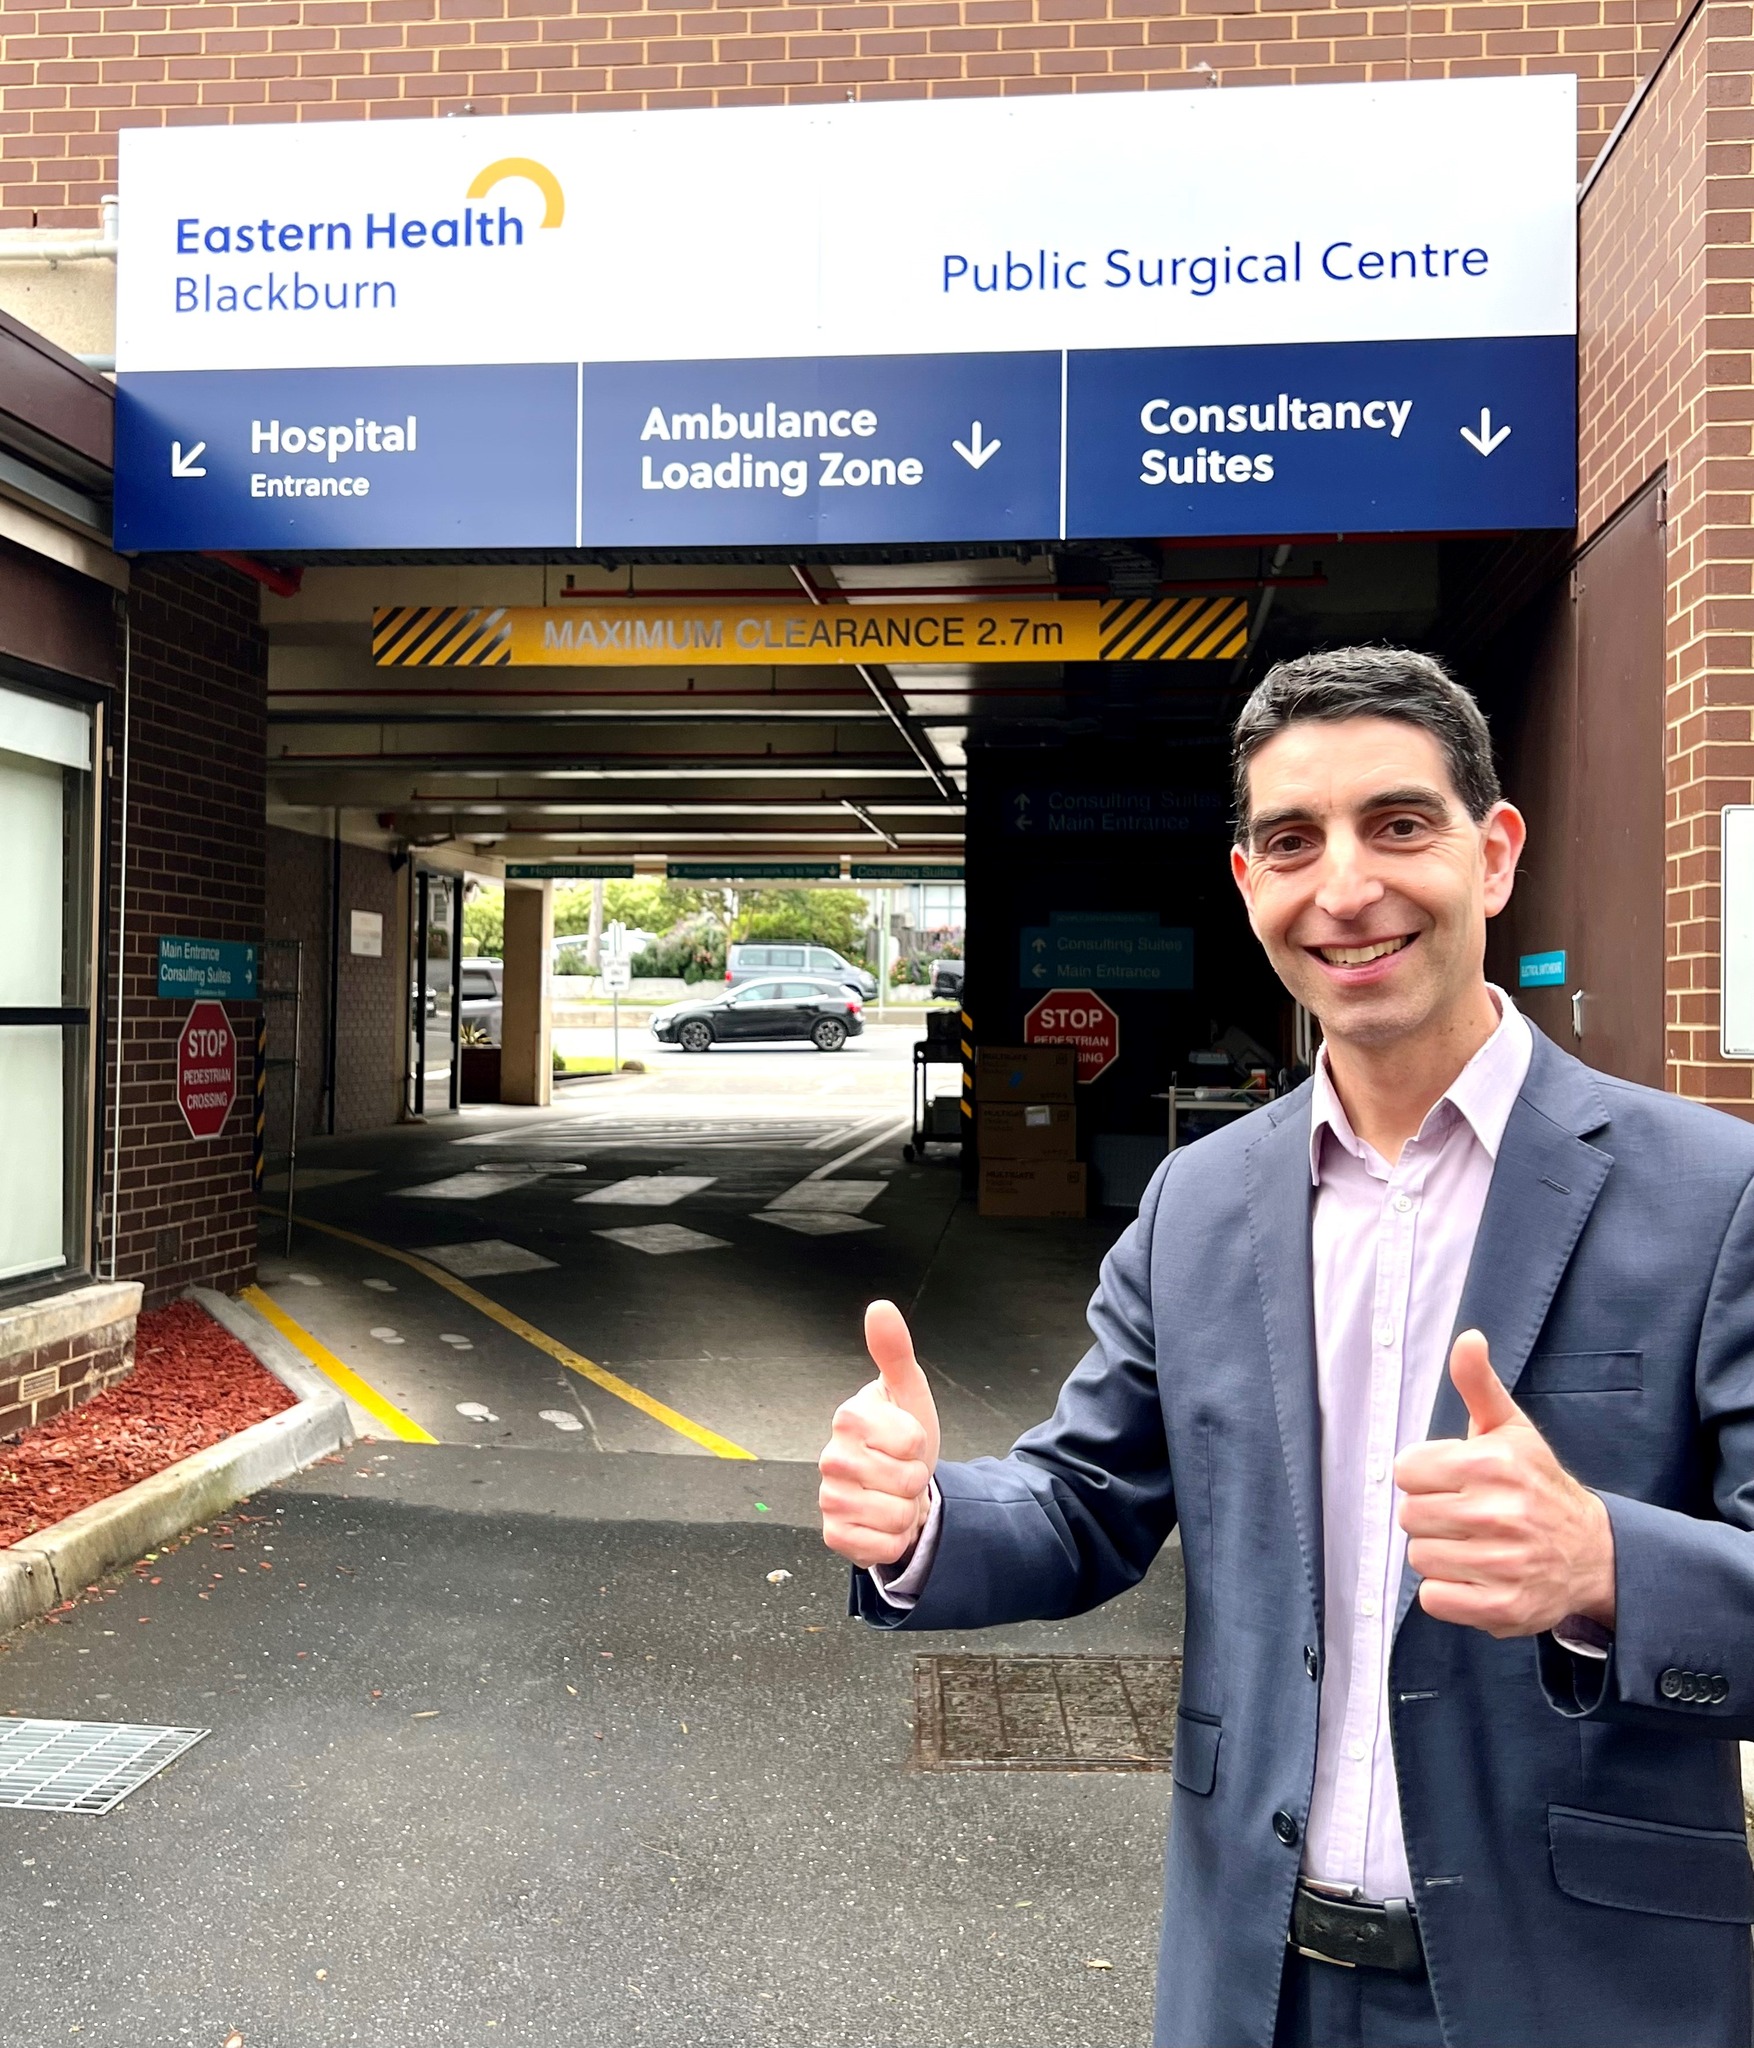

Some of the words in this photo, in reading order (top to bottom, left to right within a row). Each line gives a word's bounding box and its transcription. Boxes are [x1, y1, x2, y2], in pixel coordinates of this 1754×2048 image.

[176, 217, 351, 254] Eastern
[367, 207, 523, 249] Health
[942, 250, 1087, 293] Public
[1106, 242, 1301, 295] Surgical
[1322, 239, 1489, 281] Centre
[175, 272, 396, 312] Blackburn
[640, 403, 877, 441] Ambulance
[1140, 392, 1412, 438] Consultancy
[252, 416, 417, 462] Hospital
[642, 453, 808, 495] Loading
[819, 452, 924, 487] Zone
[1140, 448, 1274, 486] Suites
[251, 474, 369, 498] Entrance
[543, 618, 723, 651] MAXIMUM
[736, 617, 964, 649] CLEARANCE
[977, 617, 1063, 646] 2.7m
[1048, 791, 1151, 812] Consulting
[1160, 790, 1222, 808] Suites
[1048, 813, 1094, 831] Main
[1102, 813, 1190, 831] Entrance
[161, 940, 182, 957] Main
[185, 942, 219, 961] Entrance
[1057, 937, 1133, 953] Consulting
[1138, 937, 1183, 951] Suites
[161, 964, 205, 987] Consulting
[207, 966, 231, 984] Suites
[1057, 964, 1091, 978] Main
[1096, 964, 1160, 978] Entrance
[1040, 1008, 1103, 1029] STOP
[188, 1029, 228, 1058] STOP
[1034, 1035, 1109, 1047] PEDESTRIAN
[183, 1068, 231, 1085] PEDESTRIAN
[186, 1092, 228, 1110] CROSSING
